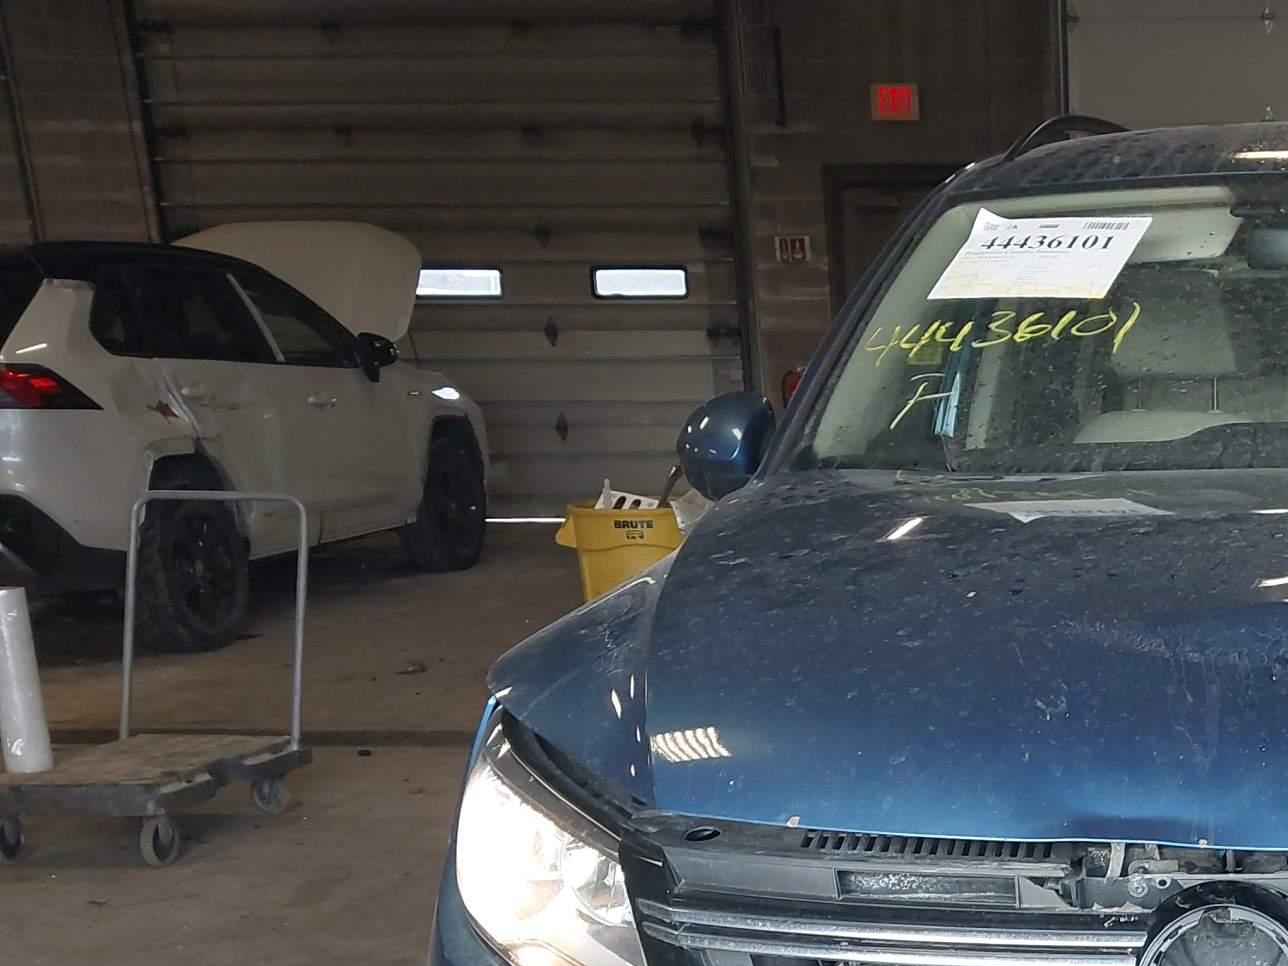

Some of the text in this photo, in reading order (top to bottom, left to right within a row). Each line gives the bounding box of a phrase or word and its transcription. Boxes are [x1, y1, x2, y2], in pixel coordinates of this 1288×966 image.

[980, 234, 1114, 250] 44436101
[865, 302, 1140, 367] 44436101
[614, 520, 654, 528] BRUTE
